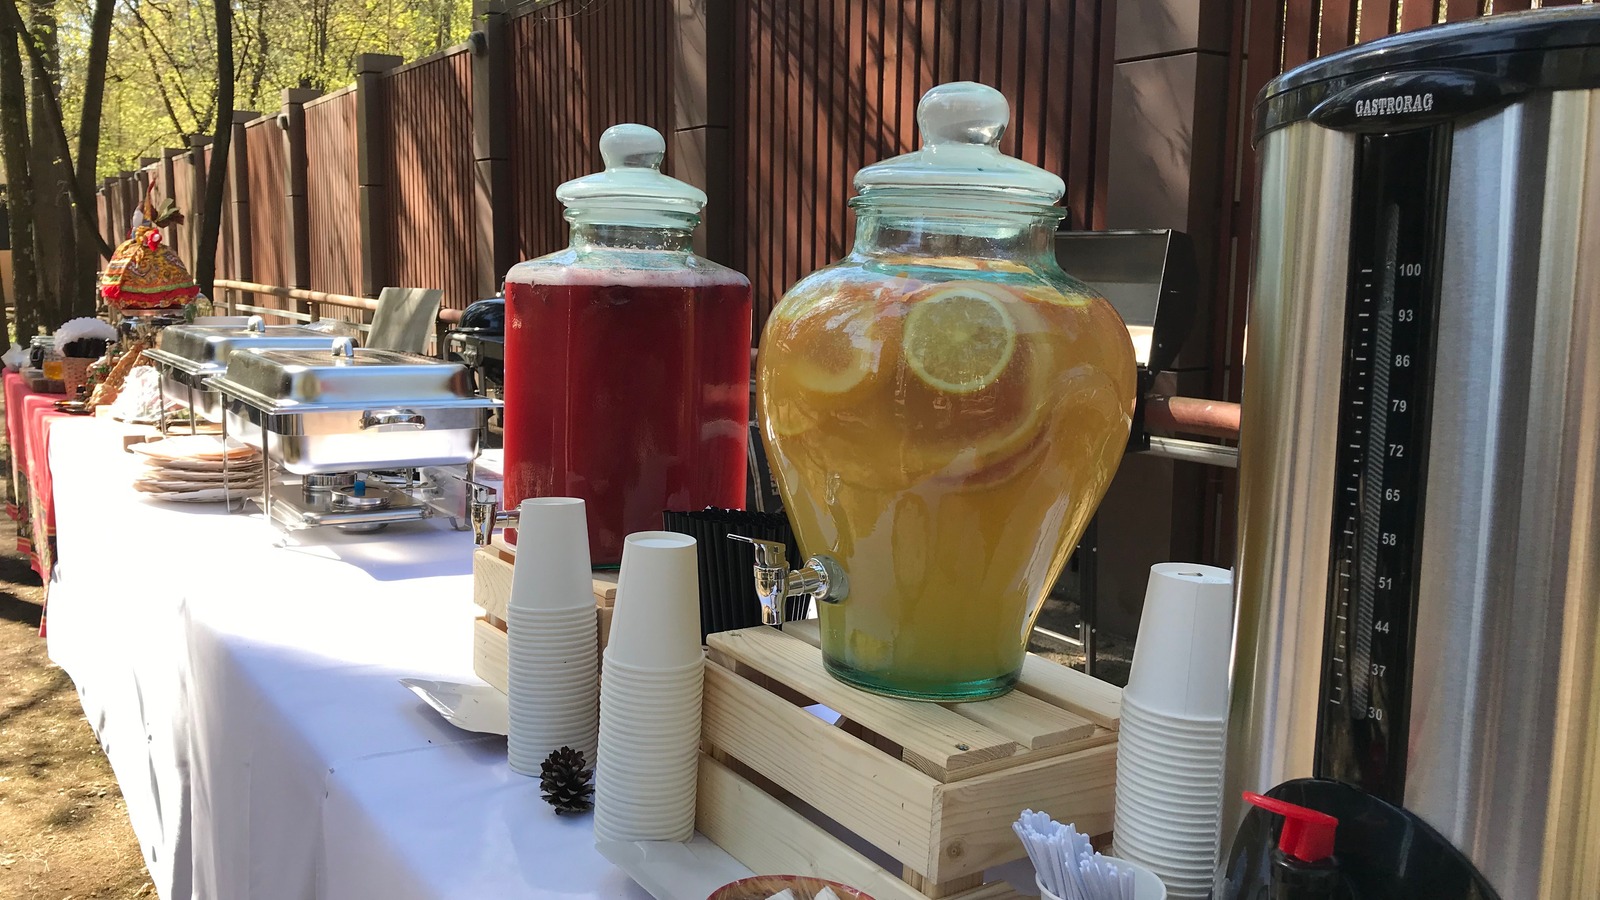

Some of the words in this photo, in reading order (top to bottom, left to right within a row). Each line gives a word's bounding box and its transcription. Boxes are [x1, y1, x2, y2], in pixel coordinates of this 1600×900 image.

[1355, 93, 1434, 117] GASTRORAG
[1398, 263, 1422, 277] 100
[1398, 309, 1415, 322] 93
[1394, 354, 1410, 367] 86
[1391, 399, 1408, 413] 79
[1388, 444, 1405, 458] 72
[1385, 489, 1401, 502] 65
[1381, 533, 1397, 546] 58
[1378, 577, 1393, 590] 51
[1374, 621, 1390, 634] 44
[1371, 664, 1387, 677] 37
[1368, 707, 1383, 721] 30
